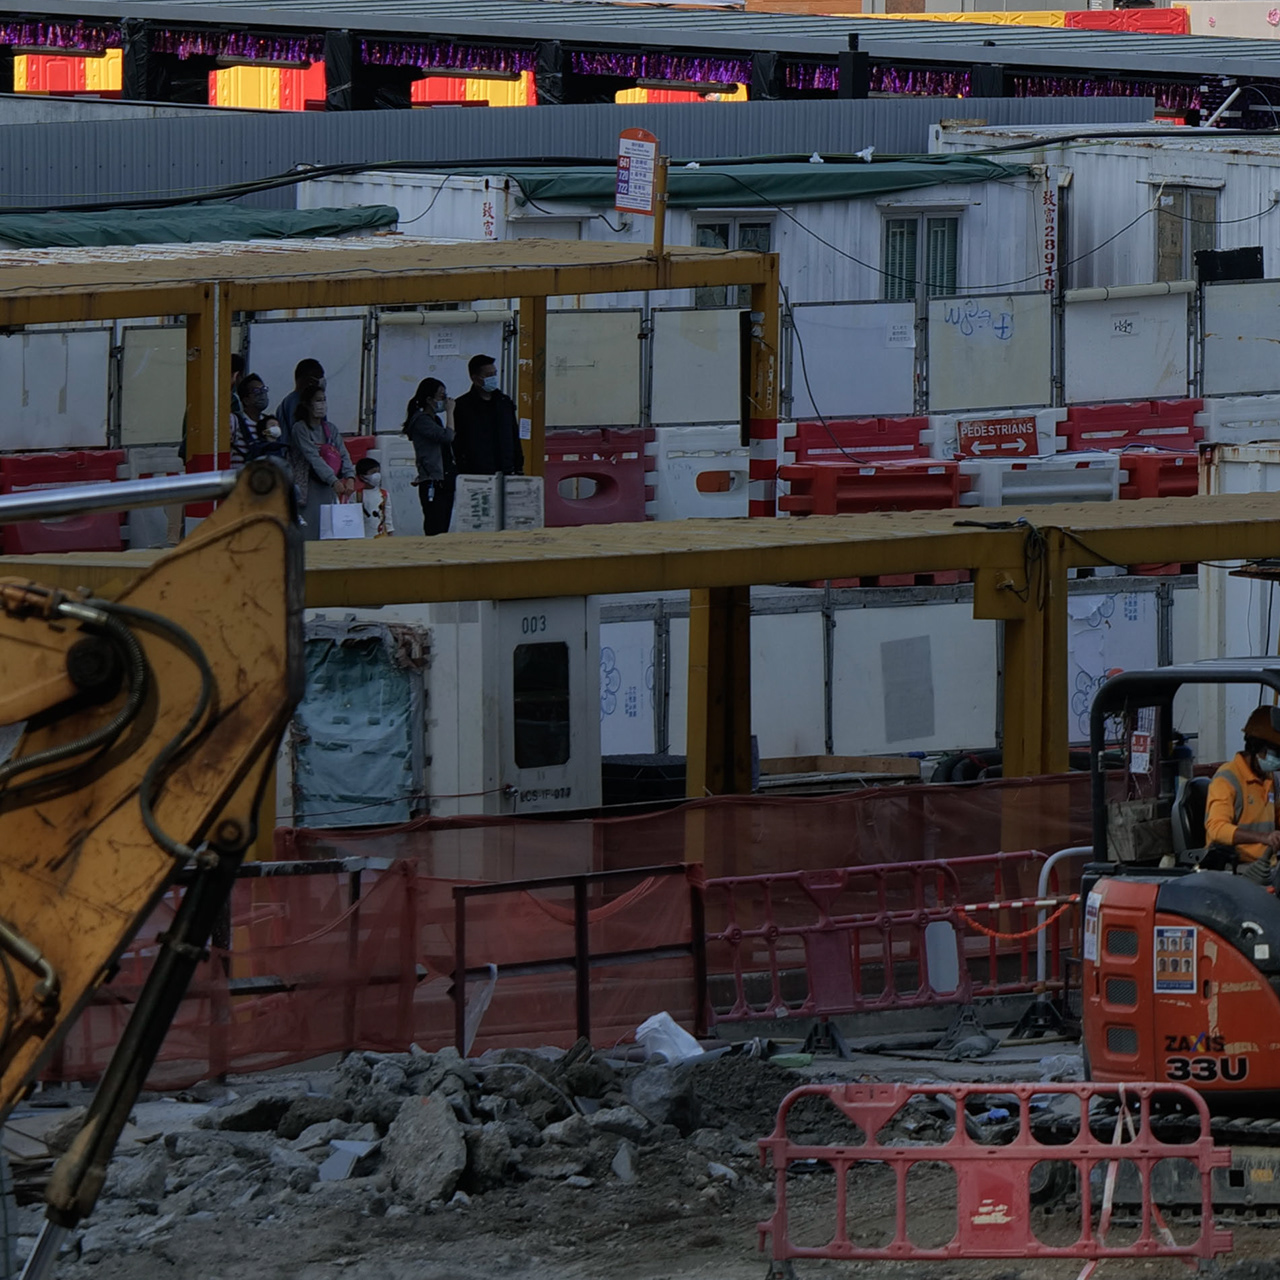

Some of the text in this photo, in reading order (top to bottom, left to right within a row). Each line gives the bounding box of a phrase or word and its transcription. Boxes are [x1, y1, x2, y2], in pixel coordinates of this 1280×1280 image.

[961, 423, 1034, 437] PEDESTRIANS
[522, 615, 547, 634] 003
[1165, 1031, 1226, 1053] ZAXIS
[1165, 1056, 1249, 1082] 33U
